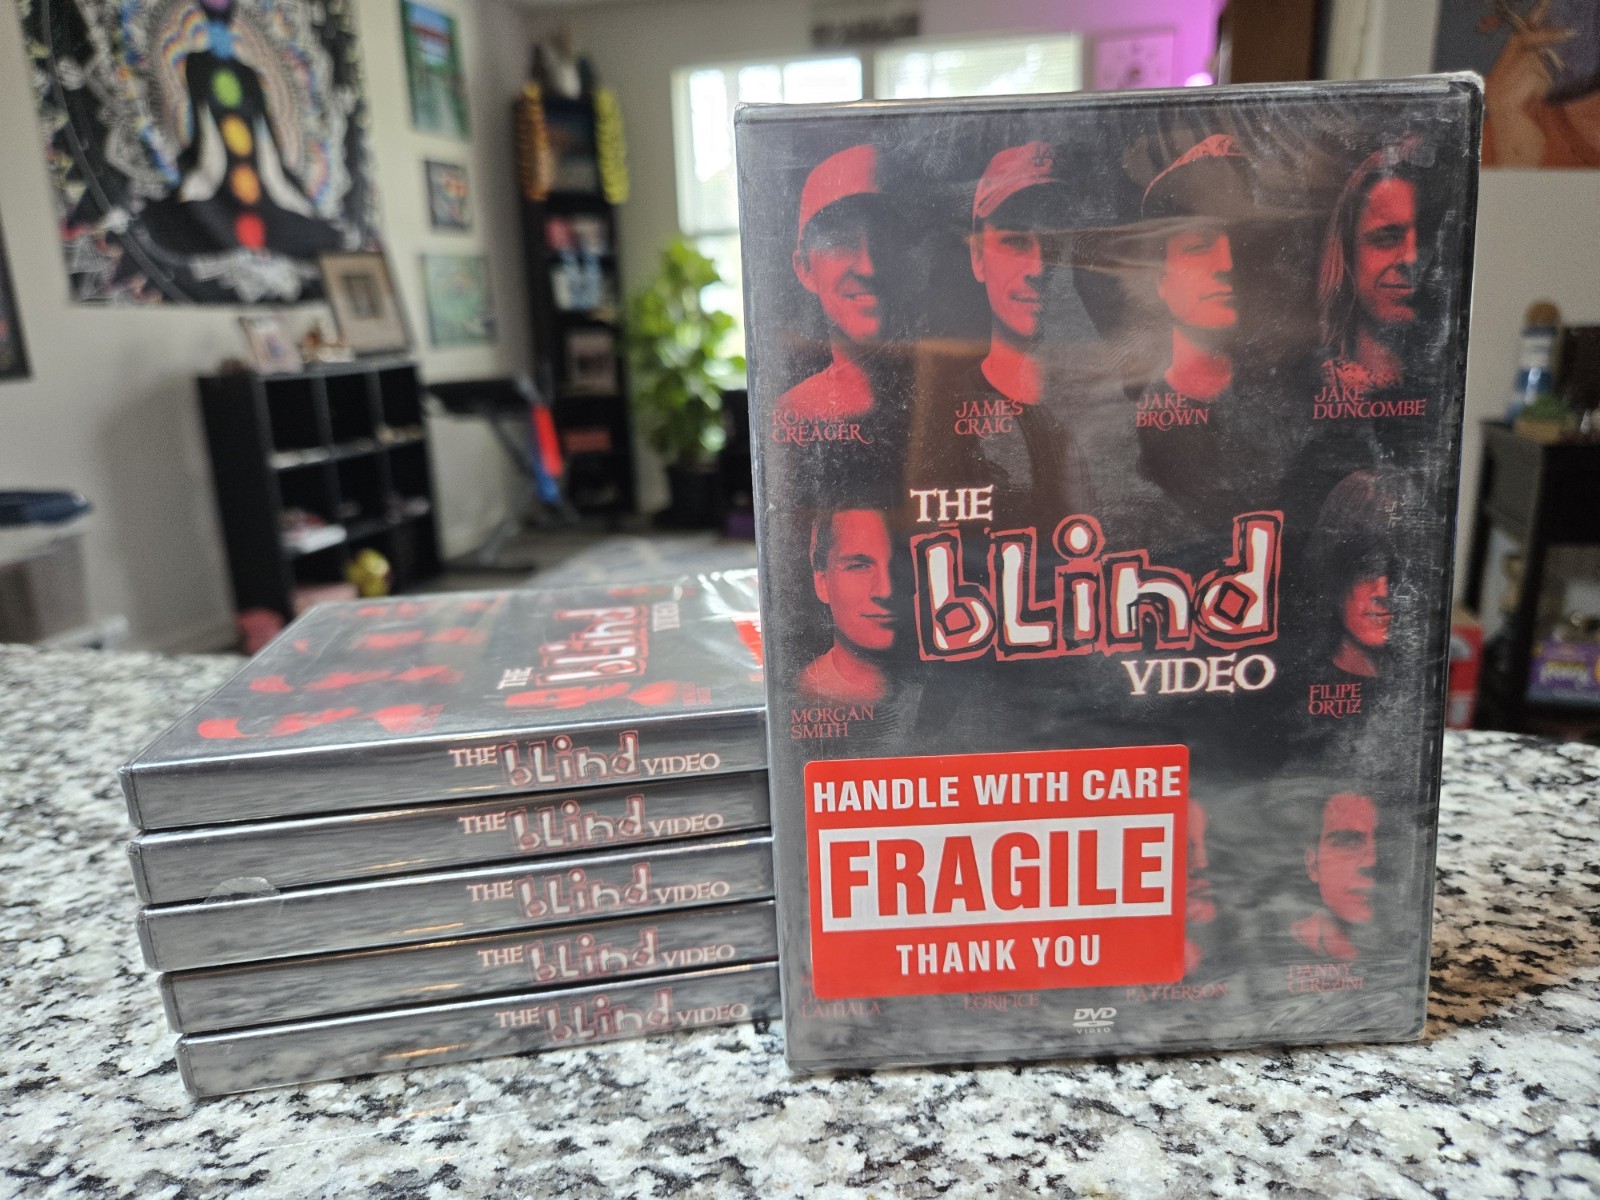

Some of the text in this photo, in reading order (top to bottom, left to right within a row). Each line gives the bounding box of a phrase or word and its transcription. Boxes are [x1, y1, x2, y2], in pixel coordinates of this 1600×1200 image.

[1136, 391, 1187, 410] JAKE
[1314, 386, 1364, 403] JAKE
[955, 399, 1023, 418] JAMES
[1136, 407, 1210, 432] BROWN
[1313, 399, 1427, 419] DUNCOMBE
[771, 423, 875, 446] CREAGER
[954, 416, 1012, 439] CRAIG
[910, 485, 994, 522] THE
[497, 667, 534, 689] THE
[1121, 653, 1277, 696] VIDEO
[1309, 682, 1362, 703] FILIPE
[790, 705, 875, 724] MORGAN
[1308, 698, 1362, 719] ORTIZ
[790, 721, 848, 739] SMITH
[449, 745, 498, 767] THE
[641, 753, 720, 775] VIDEO
[812, 765, 1182, 813] HANDLE WITH CARE
[459, 811, 507, 834] THE
[648, 813, 724, 836] VIDEO
[828, 826, 1166, 919] FRAGILE
[467, 879, 514, 902] THE
[652, 881, 731, 904] VIDEO
[477, 945, 524, 968] THE
[662, 944, 736, 967] VIDEO
[896, 934, 1101, 976] THANK YOU
[495, 1007, 540, 1029] THE
[674, 1003, 749, 1025] VIDEO
[1073, 1006, 1117, 1020] DVD
